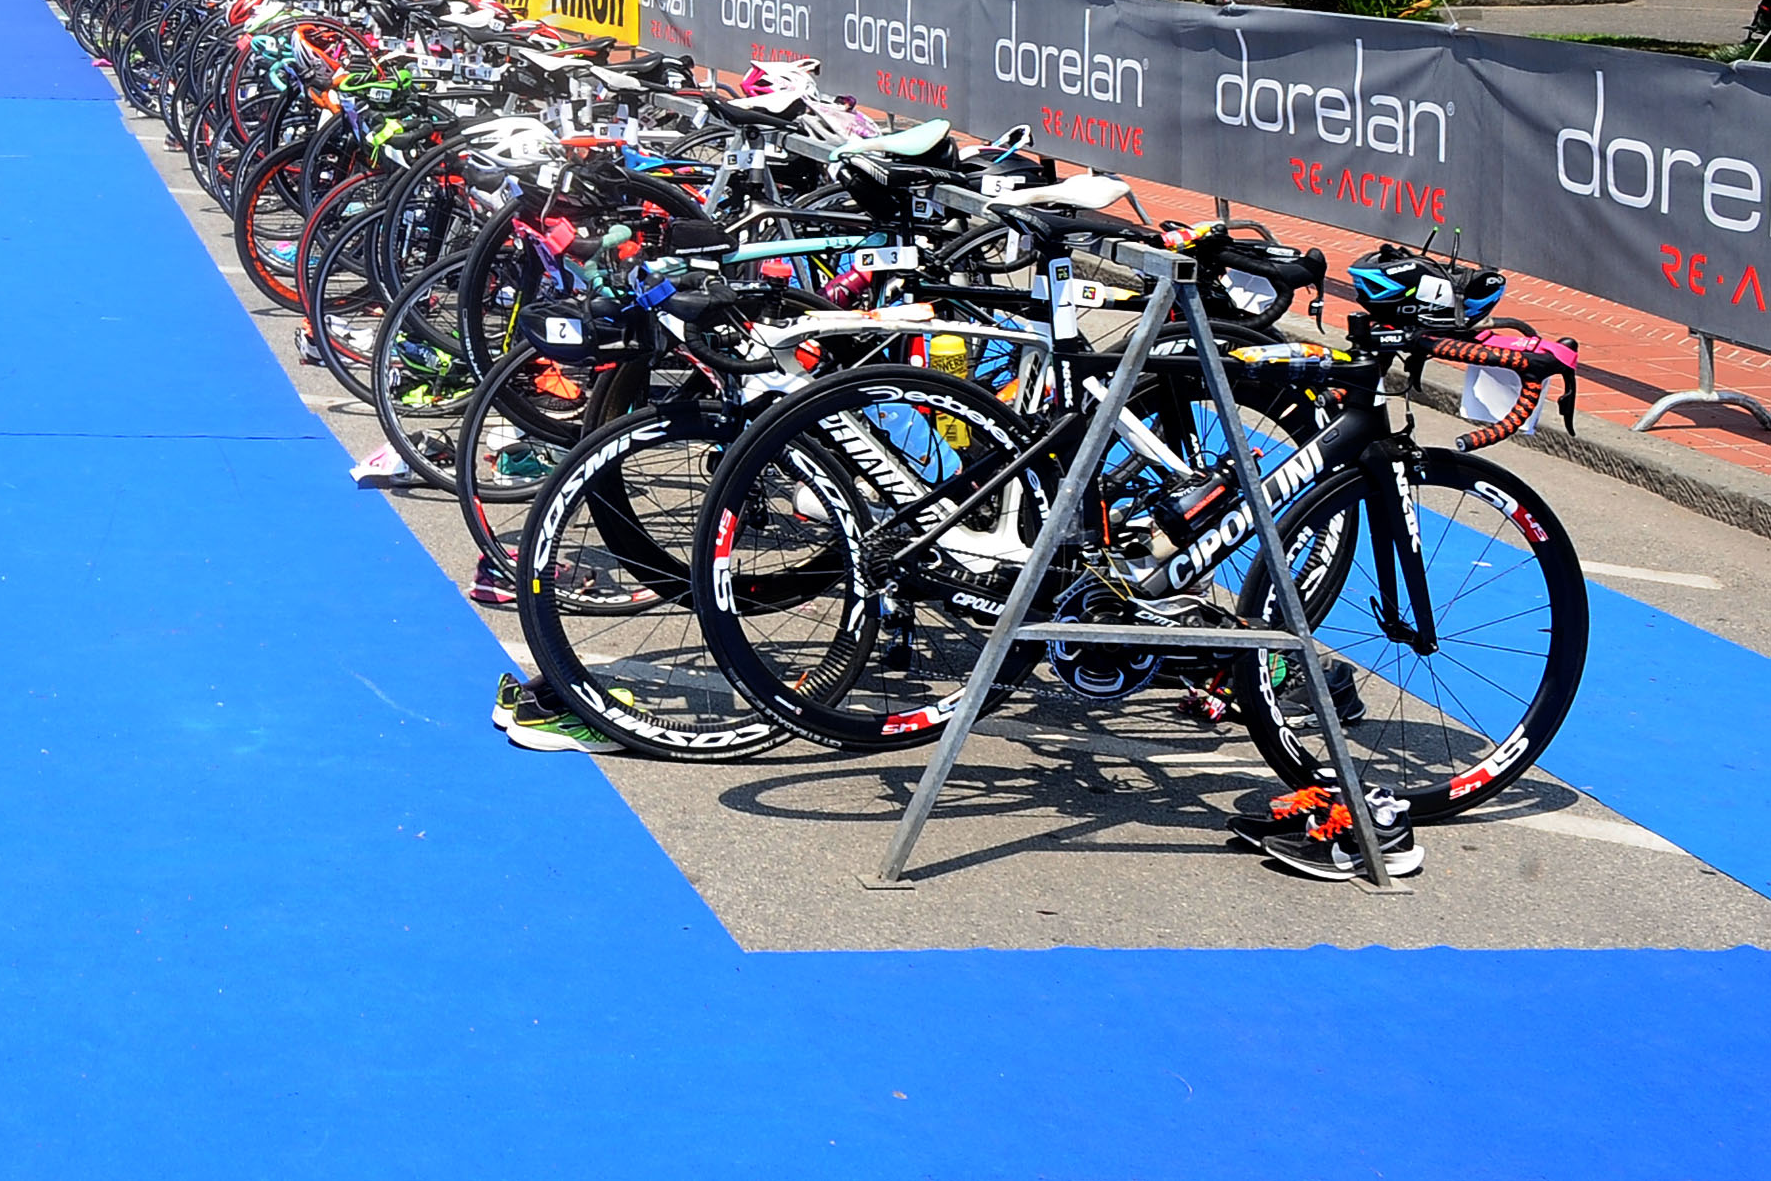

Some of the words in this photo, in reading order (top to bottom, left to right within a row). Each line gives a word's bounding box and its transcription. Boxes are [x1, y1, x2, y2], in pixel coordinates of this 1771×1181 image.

[995, 0, 1145, 108] dorelan
[1215, 29, 1447, 163] dorelan
[619, 126, 626, 138] 7
[747, 153, 754, 165] 5
[1556, 69, 1765, 233] dore
[995, 179, 1003, 193] 5
[890, 251, 899, 265] 3
[1435, 283, 1444, 301] 1
[1396, 303, 1450, 315] KOI
[558, 321, 567, 340] 2
[533, 419, 672, 571] COSMIC
[1391, 461, 1421, 554] NK1K
[786, 447, 868, 642] COSMIC
[951, 591, 1006, 617] CIPOLLI
[571, 680, 775, 748] COSMIC
